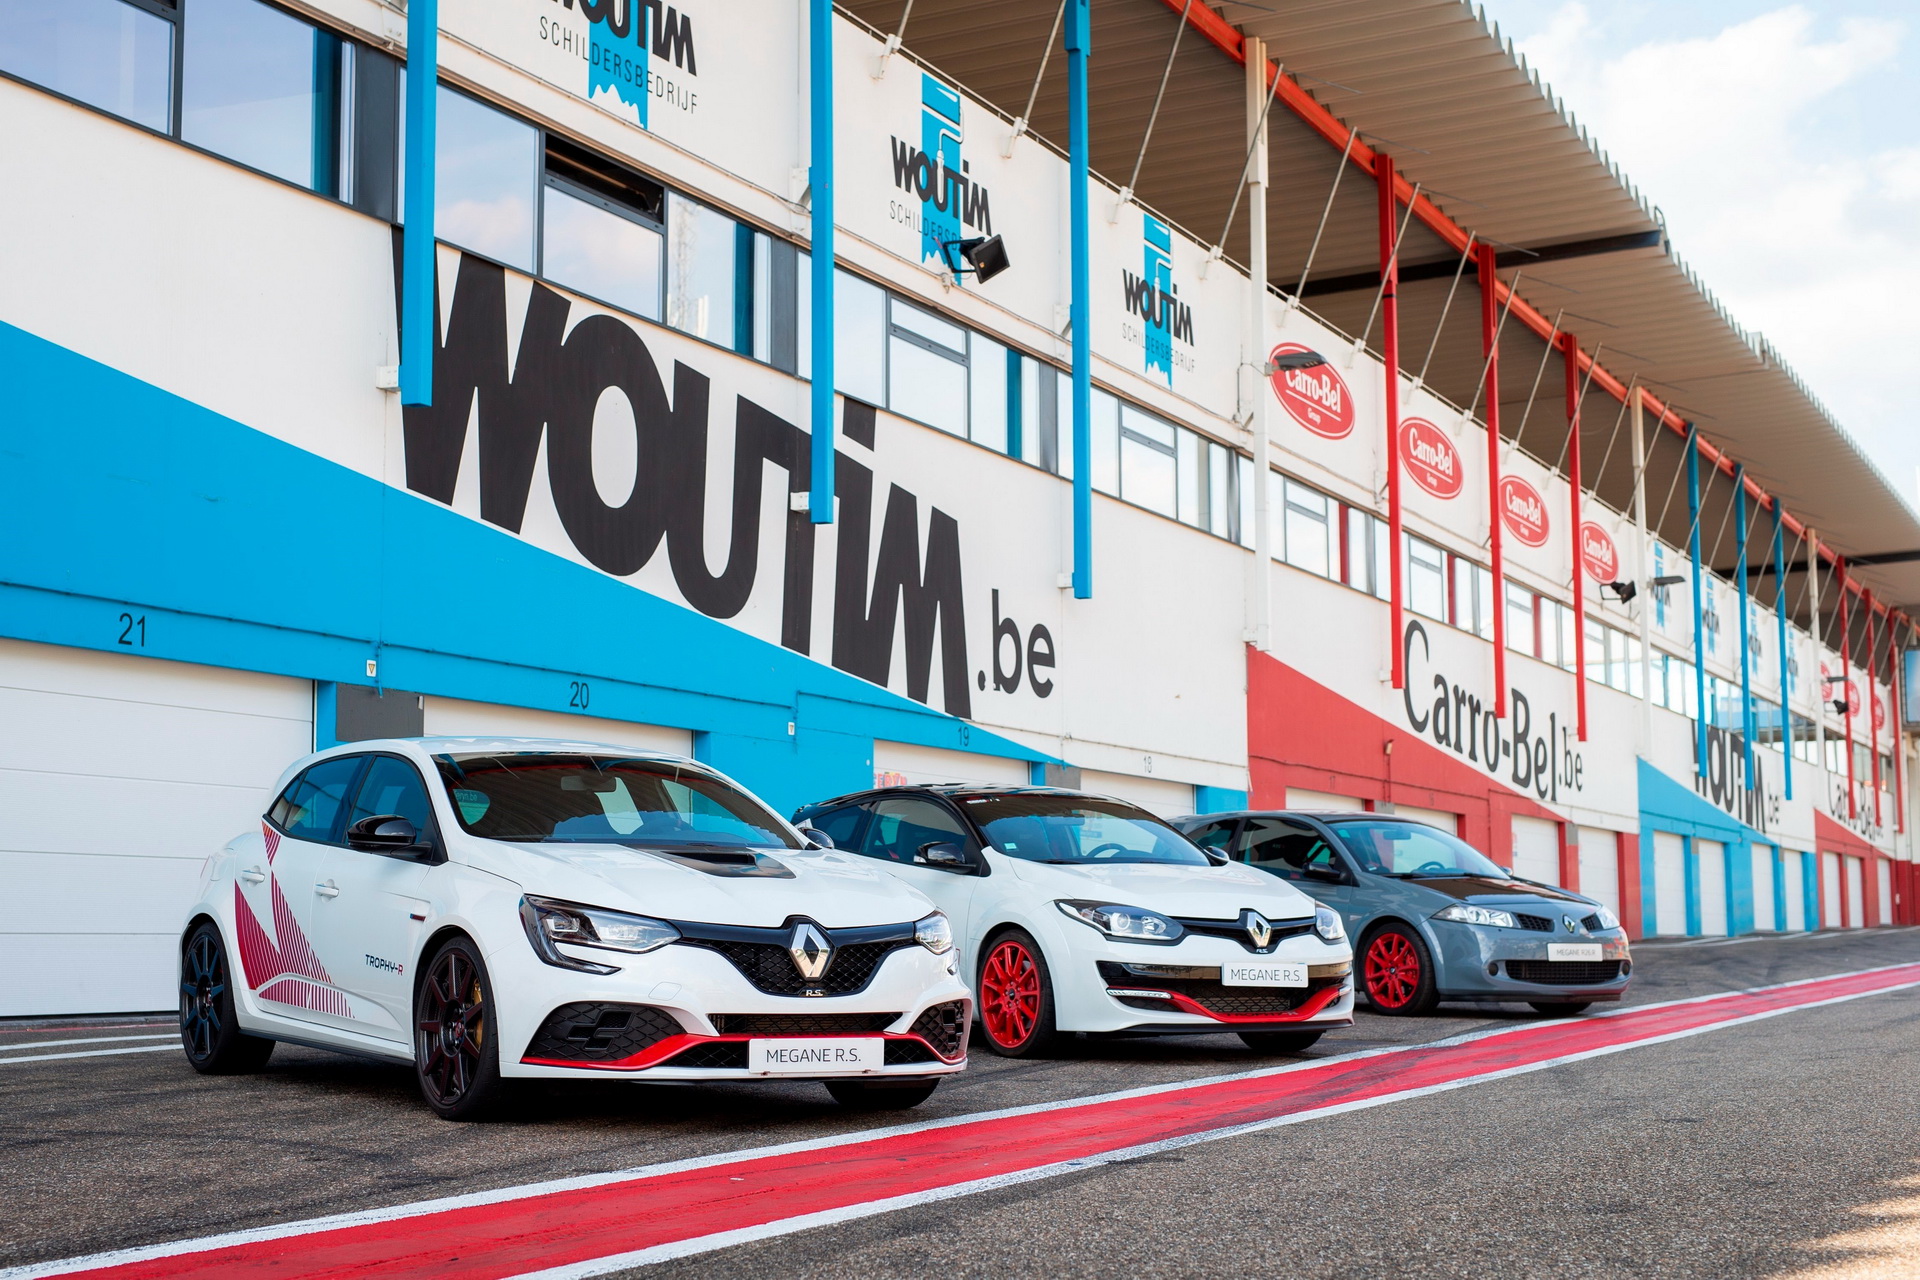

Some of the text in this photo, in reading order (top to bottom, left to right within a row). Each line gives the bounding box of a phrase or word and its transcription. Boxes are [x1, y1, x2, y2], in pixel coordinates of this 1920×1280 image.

[540, 16, 697, 114] SCHILDERSBEDRIJF
[1409, 427, 1453, 476] Carro-Bel
[1506, 484, 1542, 526] Carro-Bel
[118, 613, 145, 647] 21
[570, 681, 590, 710] 20
[1403, 619, 1583, 805] Carro-Bel.be
[958, 726, 969, 747] 19
[1143, 755, 1153, 774] 18
[365, 953, 404, 976] TROPHY-R
[1230, 968, 1303, 982] MEGANE R.S.
[805, 989, 824, 997] R.S.
[766, 1048, 861, 1063] MEGANE R.S.
